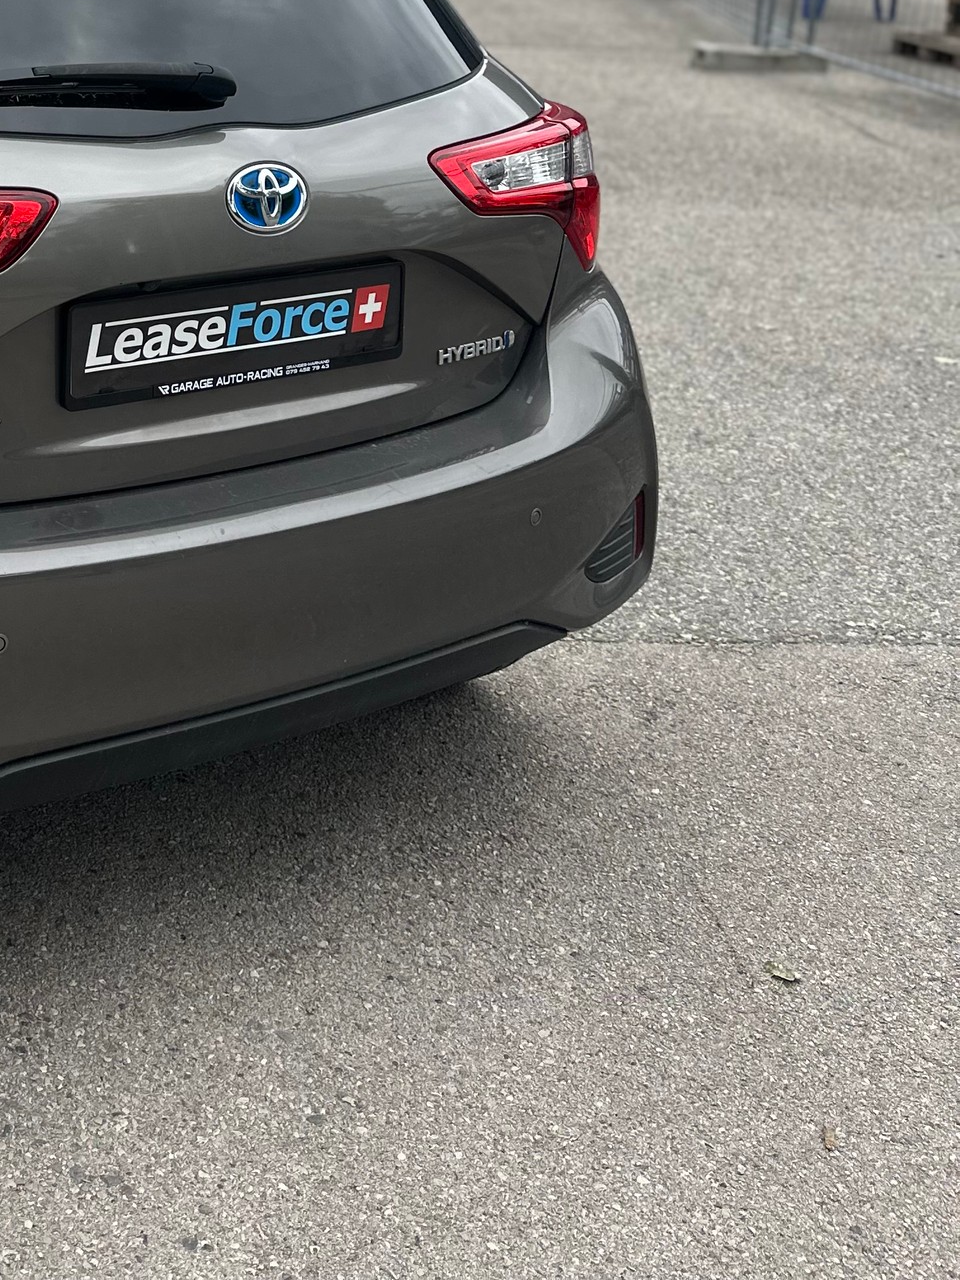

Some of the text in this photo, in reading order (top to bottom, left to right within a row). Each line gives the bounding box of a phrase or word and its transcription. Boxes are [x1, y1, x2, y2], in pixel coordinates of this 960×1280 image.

[85, 299, 349, 368] LeaseForce
[438, 336, 503, 366] HYBRID
[171, 378, 214, 394] GARAGE
[216, 366, 283, 387] AUTO-RACING
